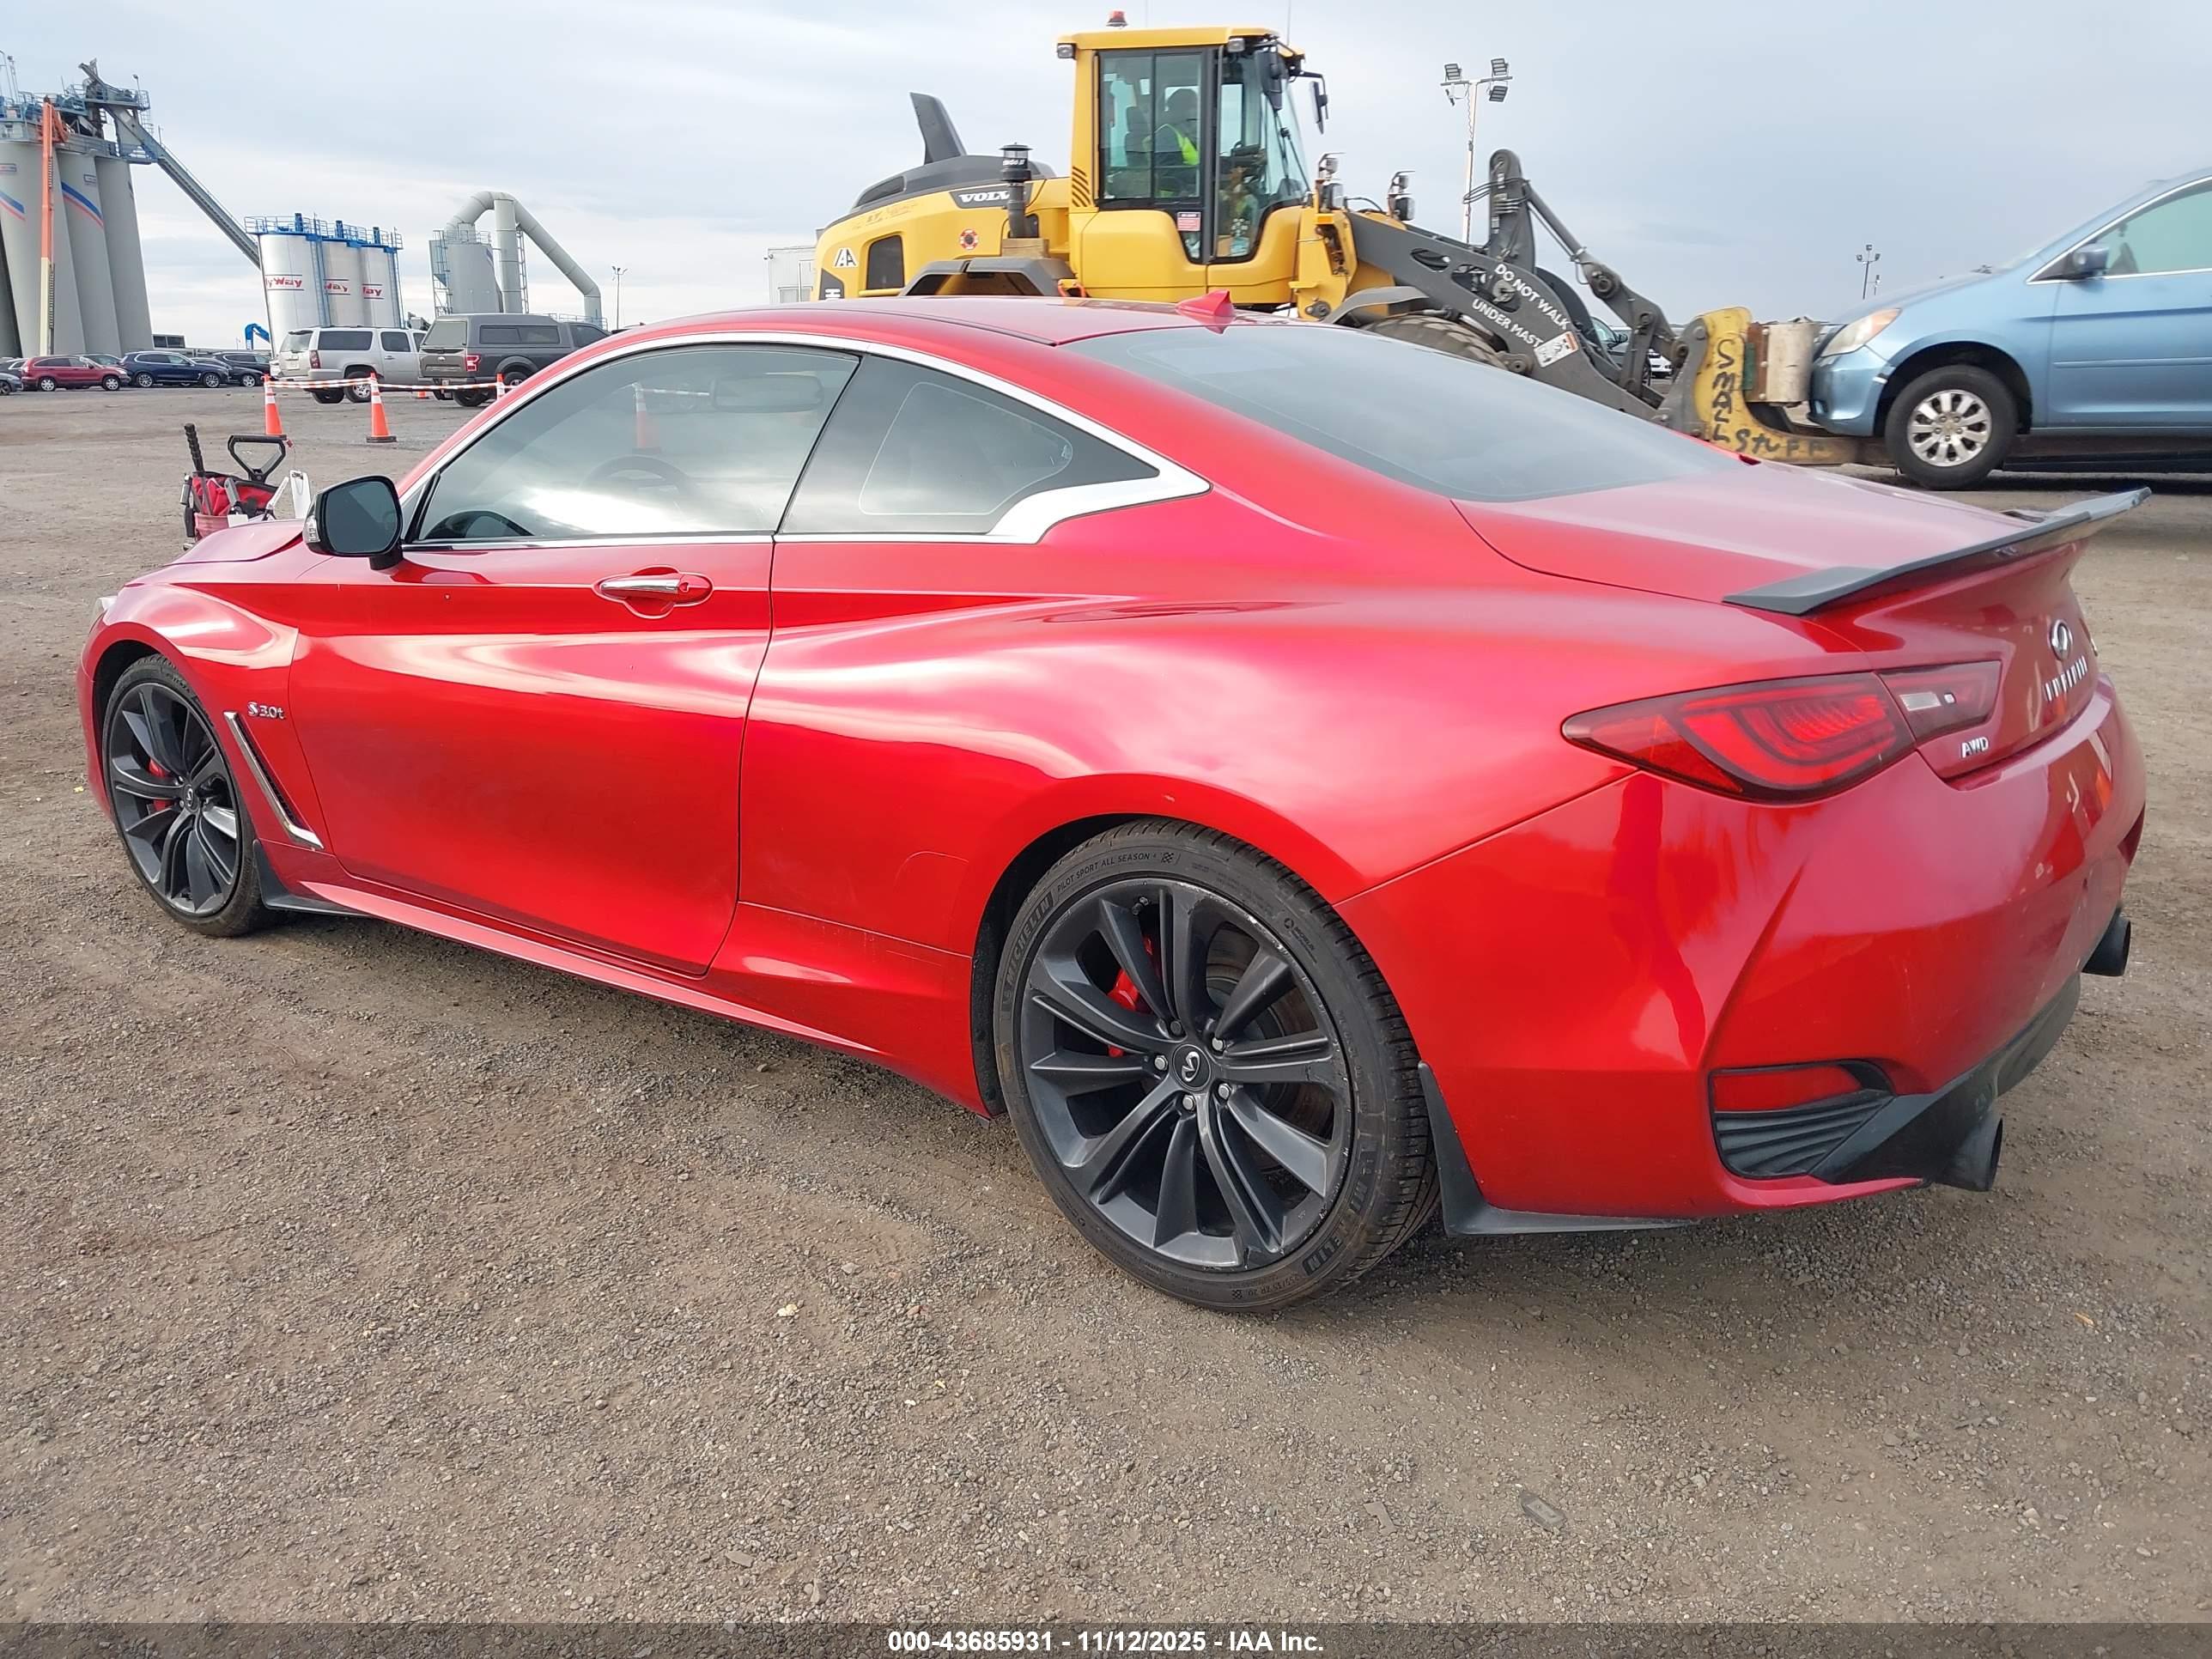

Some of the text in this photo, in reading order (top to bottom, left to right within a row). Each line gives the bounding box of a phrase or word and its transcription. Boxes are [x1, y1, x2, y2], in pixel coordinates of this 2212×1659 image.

[958, 190, 1012, 204] VOLV
[1494, 264, 1571, 330] DO NOT WALK
[1472, 299, 1544, 348] UNDER MAST
[1961, 737, 1989, 758] AWD
[1006, 853, 1150, 987] MICHELIN PILOT SPORT ALL SEASON
